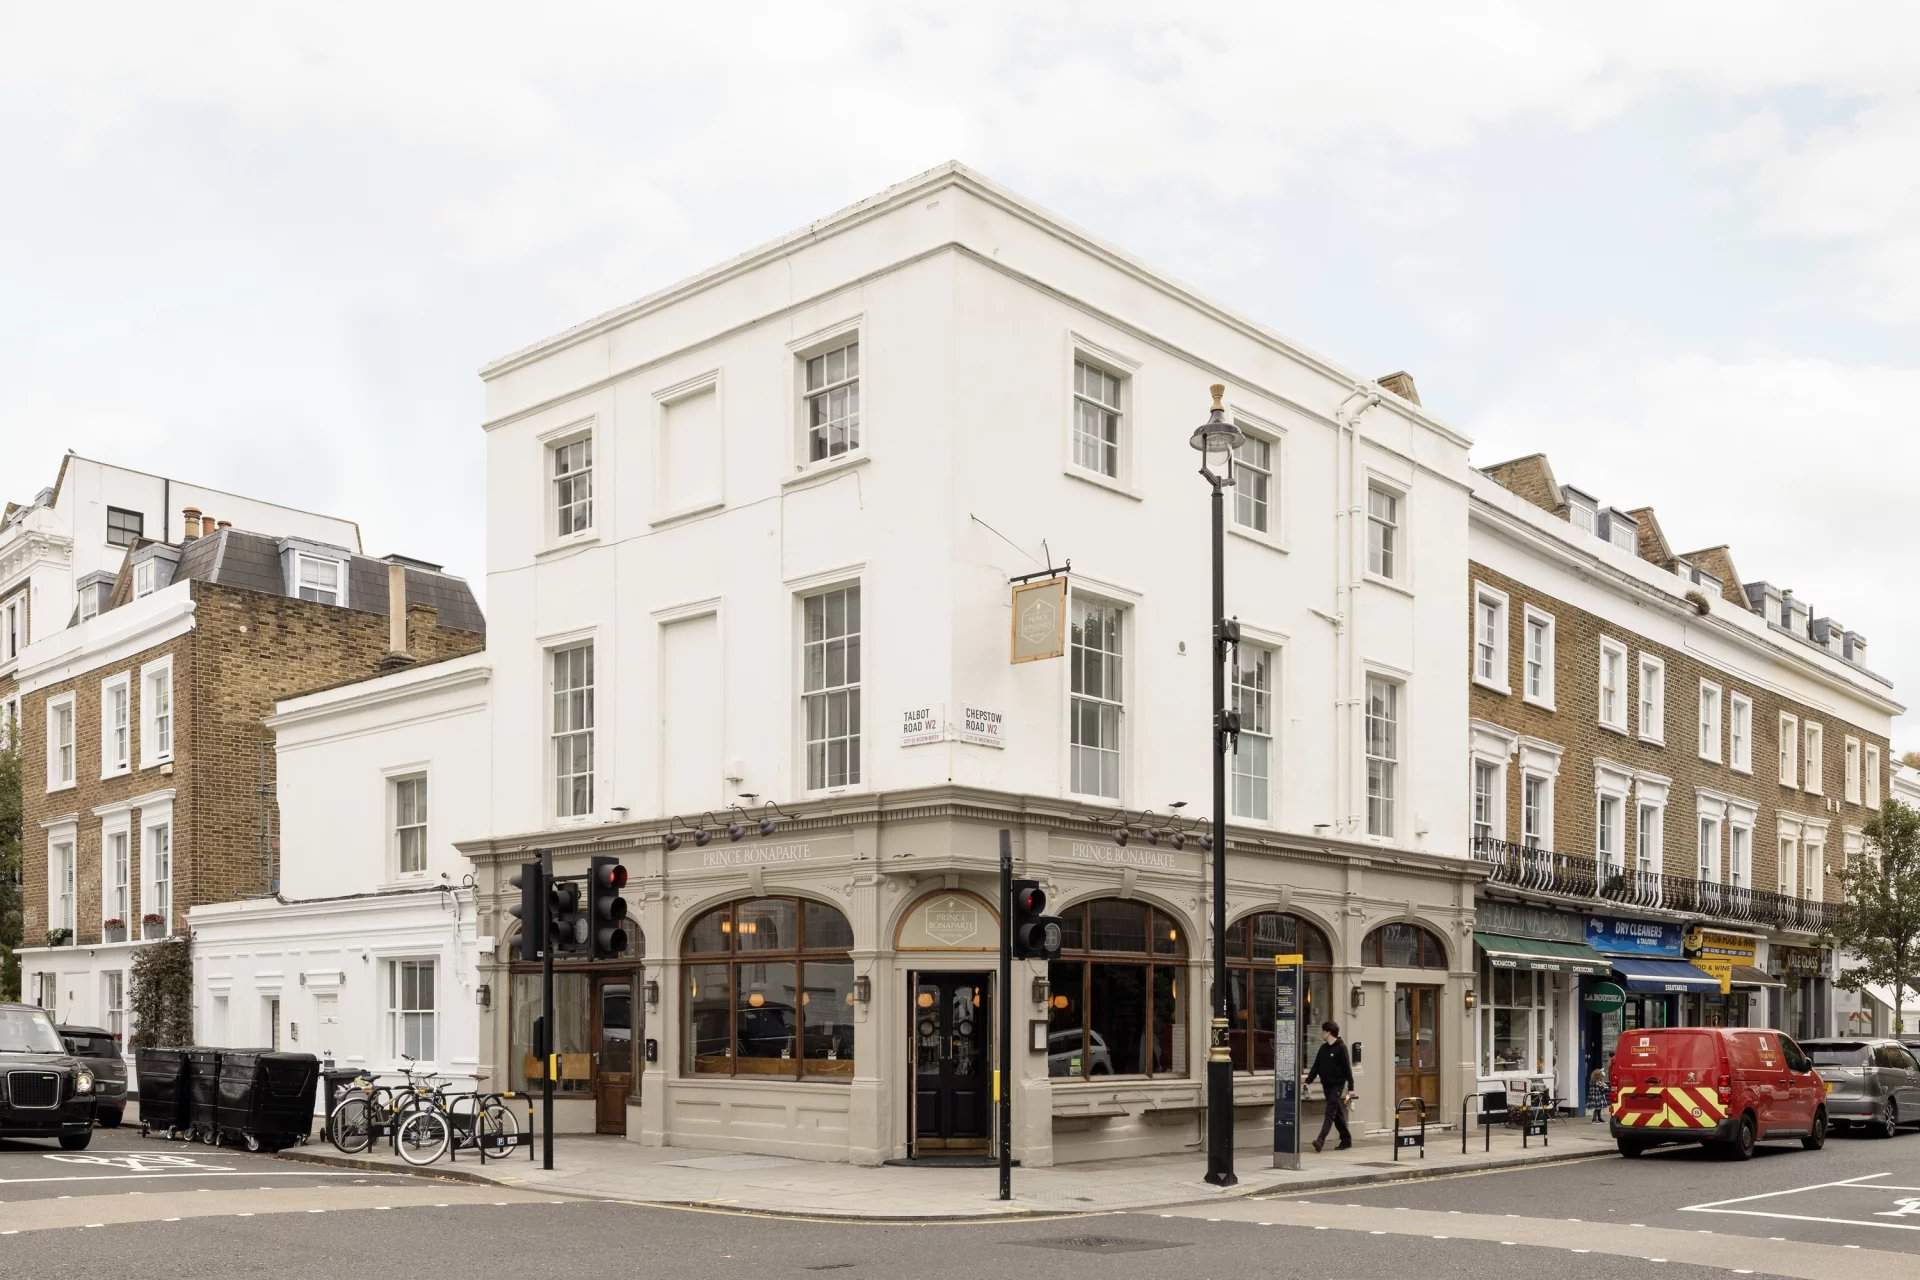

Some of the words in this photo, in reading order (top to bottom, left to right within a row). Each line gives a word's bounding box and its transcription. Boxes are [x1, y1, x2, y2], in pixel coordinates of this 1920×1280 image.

[904, 709, 929, 722] TALBOT
[966, 707, 1002, 724] CHEPSTOW
[903, 722, 923, 734] ROAD
[925, 720, 936, 730] W2
[965, 719, 985, 733] ROAD
[987, 723, 998, 735] W2
[703, 848, 741, 866] PRINCE
[744, 843, 811, 864] BONAPARTE
[1072, 842, 1112, 861] PRINCE
[1114, 847, 1176, 868] BONAPARTE
[1615, 921, 1630, 935] DRY
[1630, 923, 1663, 938] CLEANERS
